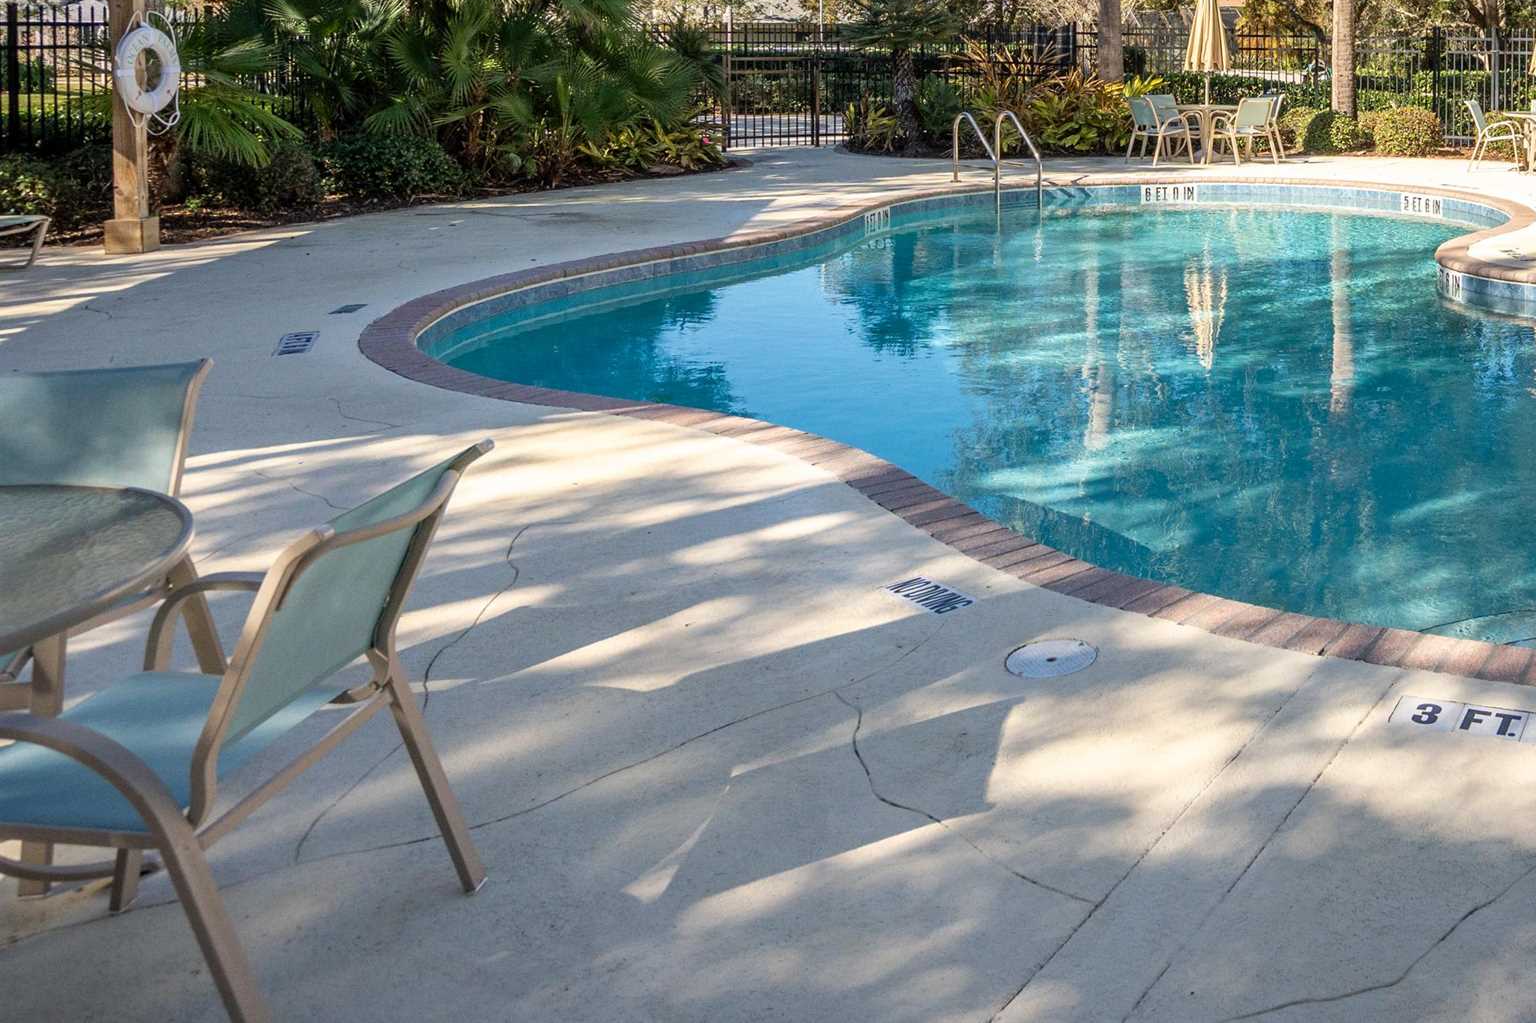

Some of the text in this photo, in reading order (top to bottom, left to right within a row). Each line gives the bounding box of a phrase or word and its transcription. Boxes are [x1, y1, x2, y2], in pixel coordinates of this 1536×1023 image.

[1184, 186, 1194, 200] IN
[1432, 199, 1440, 215] IN
[1411, 703, 1442, 725] 3
[1459, 708, 1522, 737] FT.
